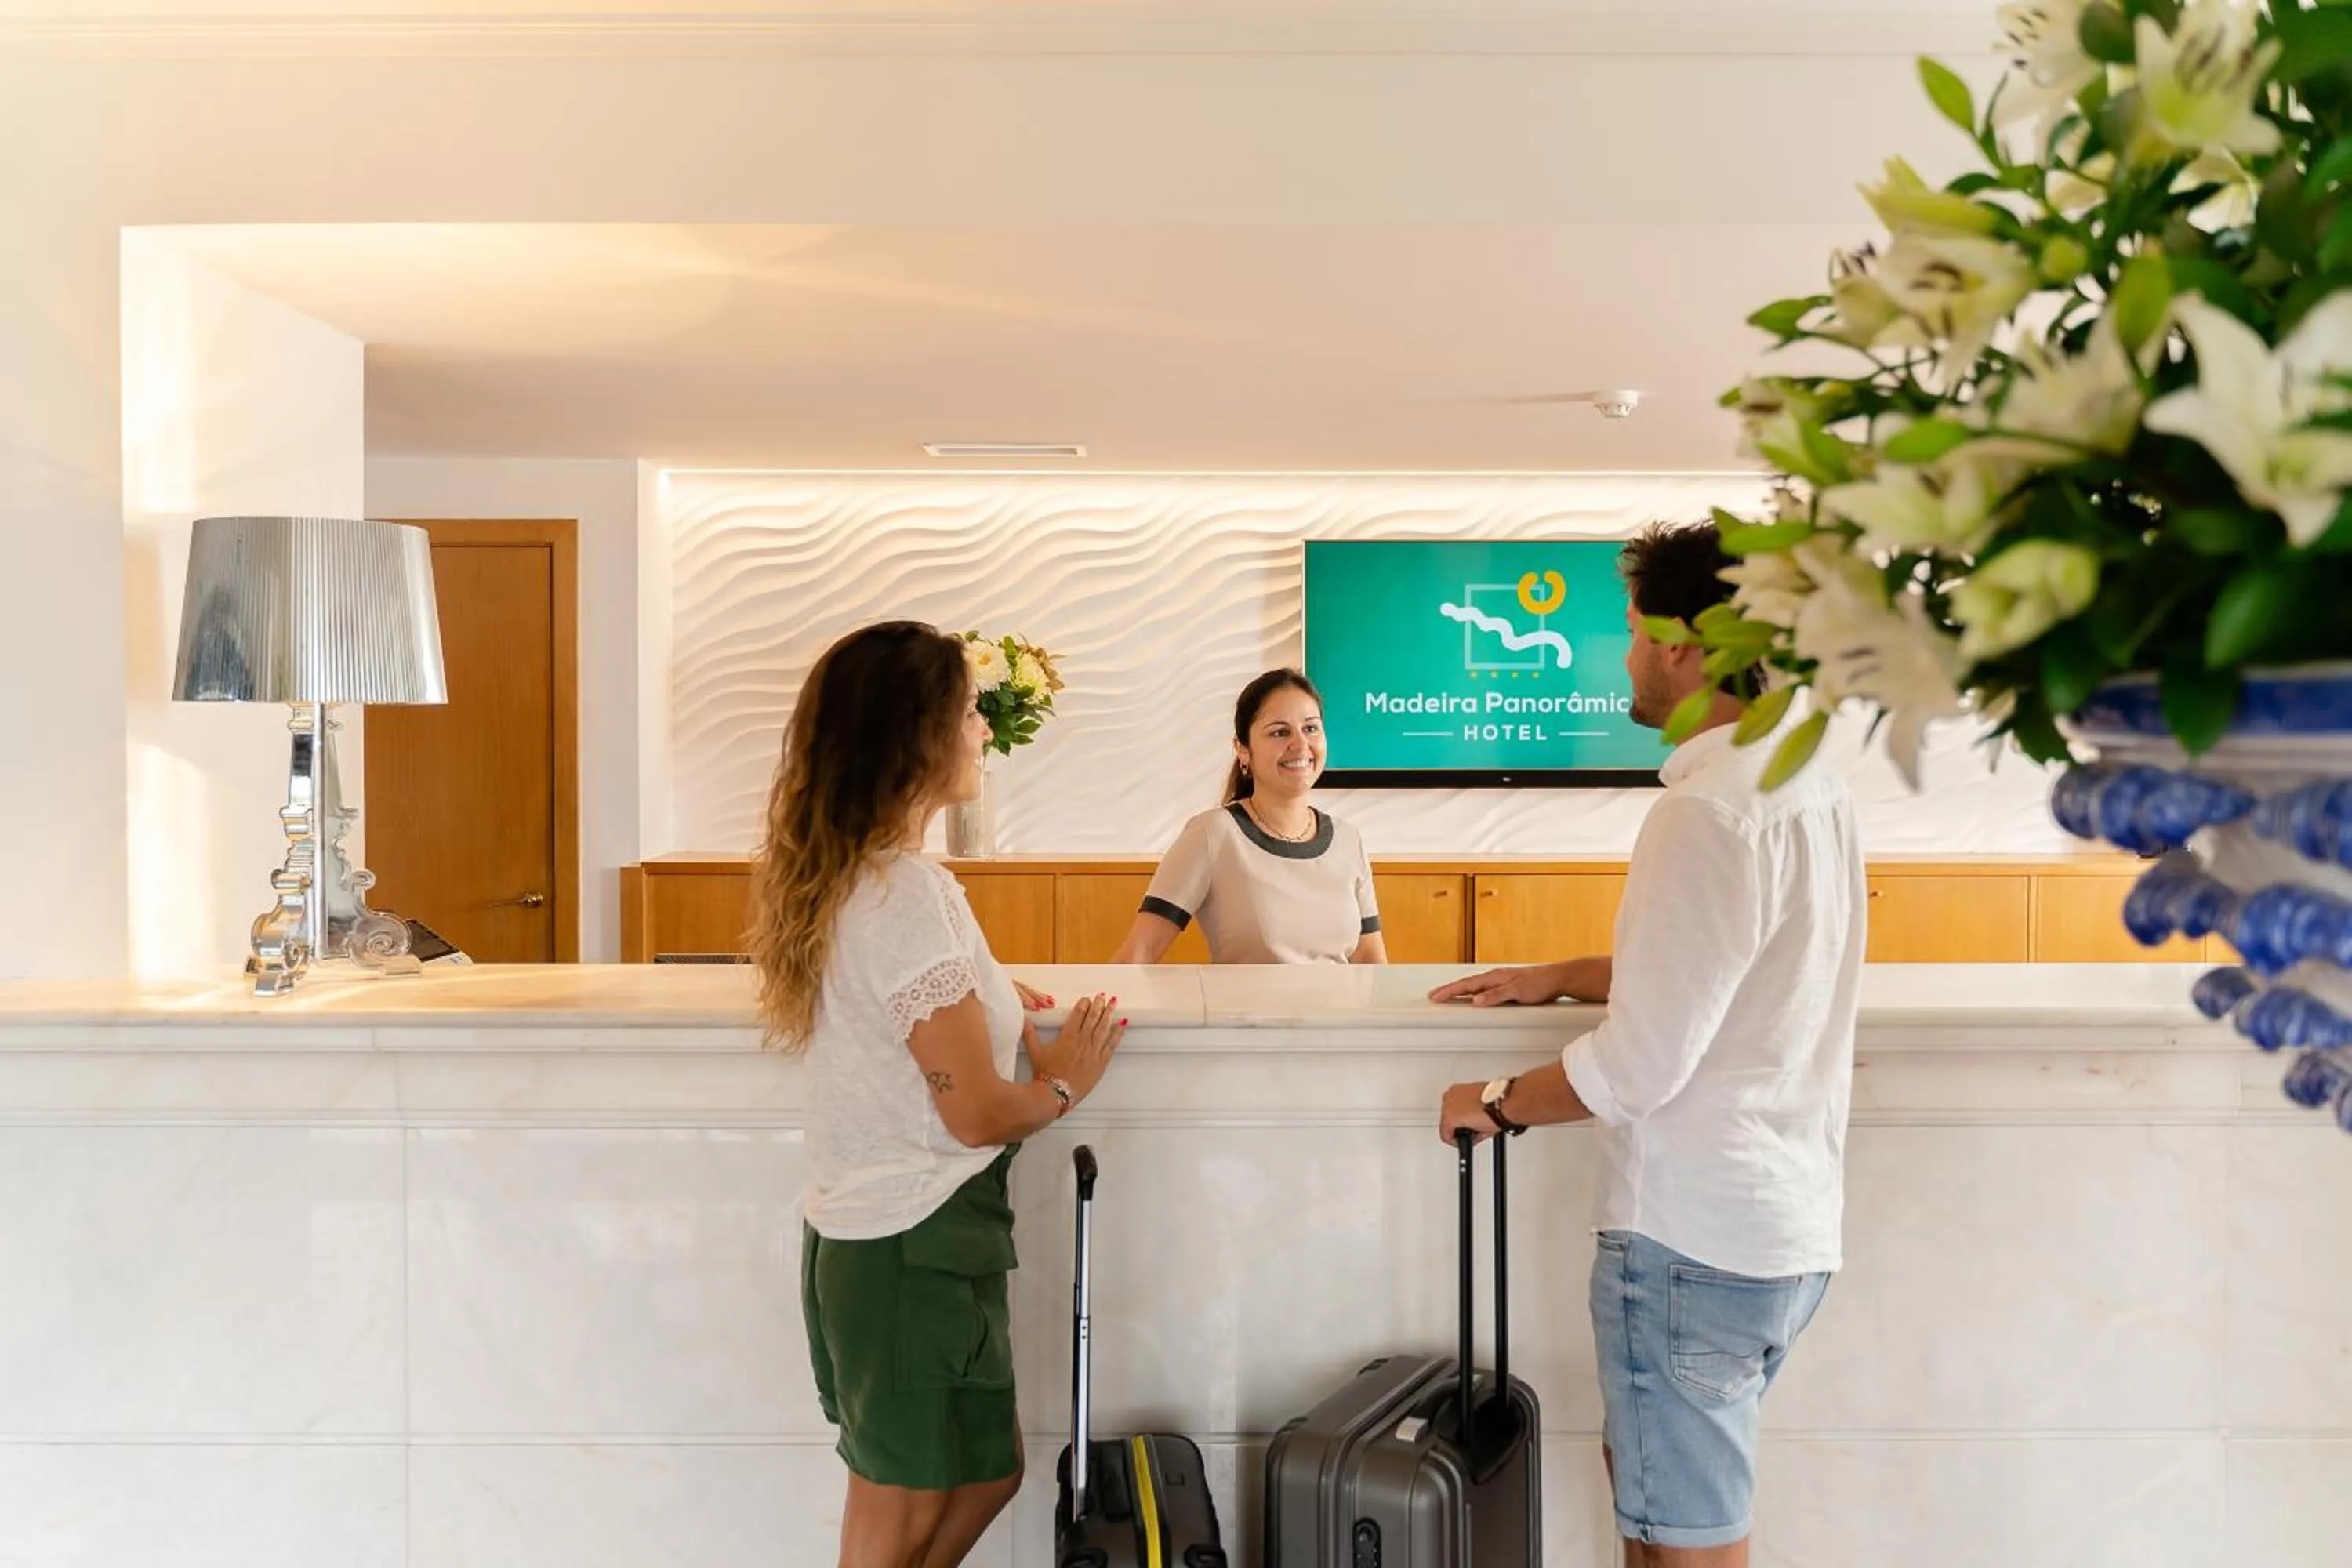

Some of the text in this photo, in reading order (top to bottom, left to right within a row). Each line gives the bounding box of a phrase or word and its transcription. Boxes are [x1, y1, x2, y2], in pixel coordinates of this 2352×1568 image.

[1365, 691, 1632, 713] Madeira Panorâmic
[1464, 724, 1548, 741] HOTEL
